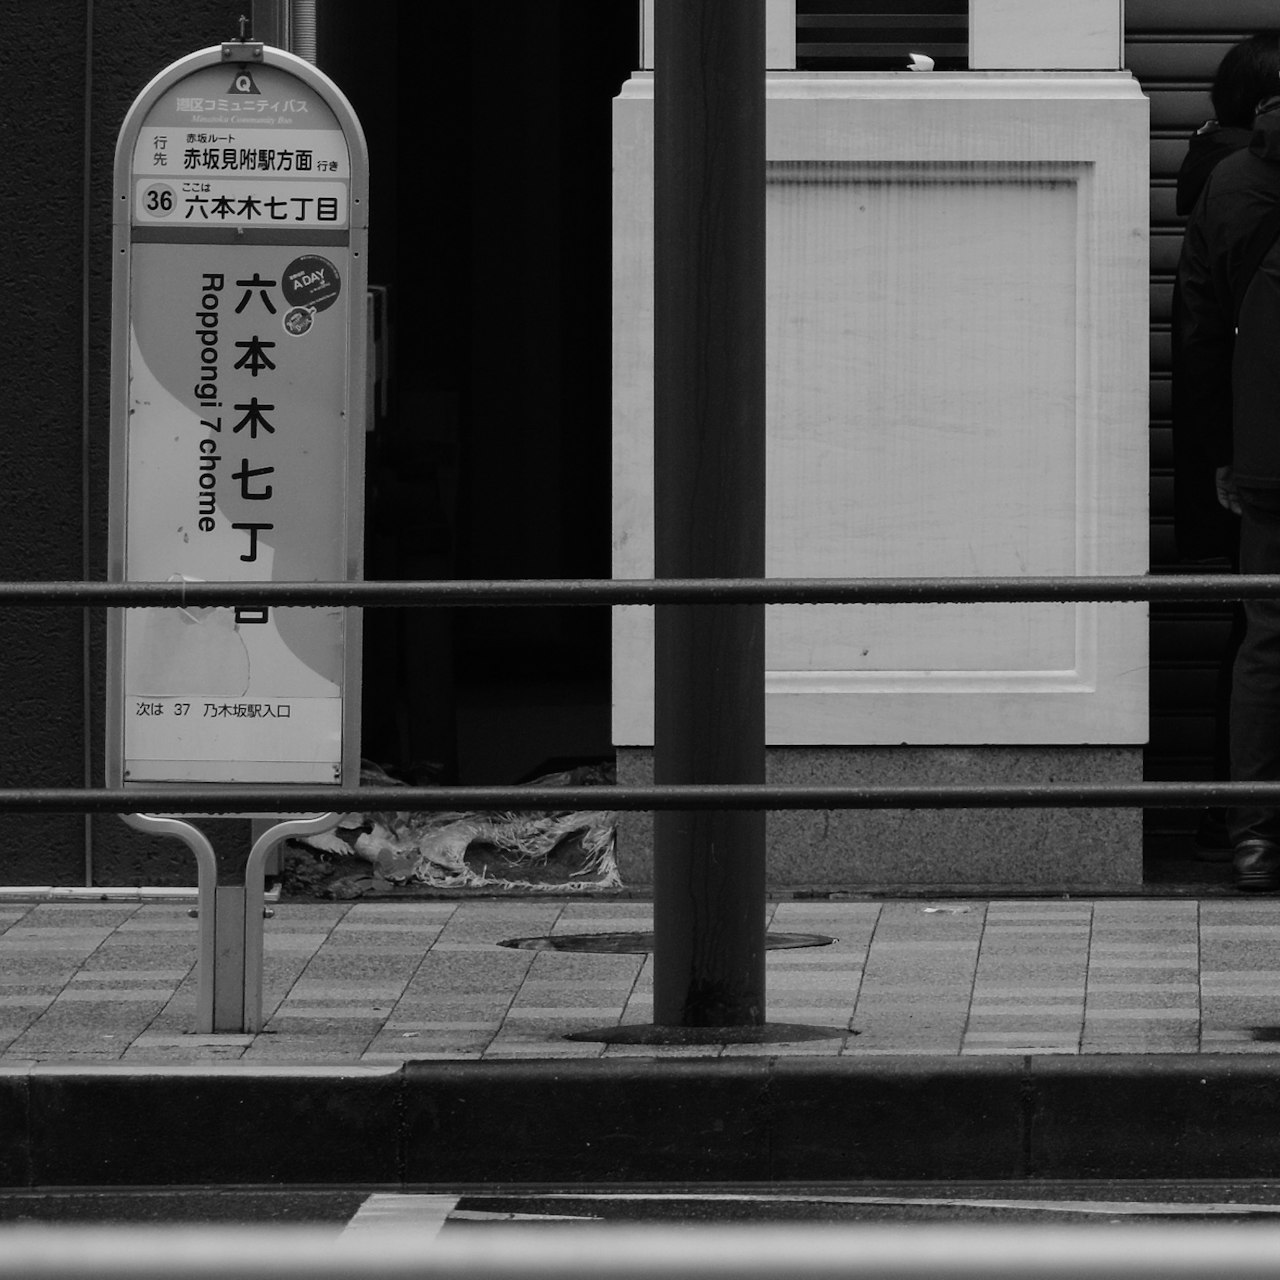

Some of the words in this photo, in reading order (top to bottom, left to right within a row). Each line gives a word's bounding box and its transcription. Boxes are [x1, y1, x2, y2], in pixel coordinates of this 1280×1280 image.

[176, 97, 309, 113] 港区コミュニティバス
[186, 133, 236, 144] 赤坂ルート
[153, 135, 168, 168] 行先
[184, 148, 313, 171] 赤坂見附駅方面
[317, 160, 338, 172] 行き
[181, 182, 211, 193] ここは
[147, 190, 173, 211] 36
[185, 194, 338, 221] 六本木七丁目
[294, 279, 304, 290] A
[302, 268, 325, 286] DAY
[195, 273, 224, 409] Roppongi
[200, 416, 222, 434] 7
[198, 438, 222, 532] chome
[136, 703, 163, 716] 次は
[173, 703, 191, 716] 37
[202, 704, 291, 718] 乃木坂駅入口
